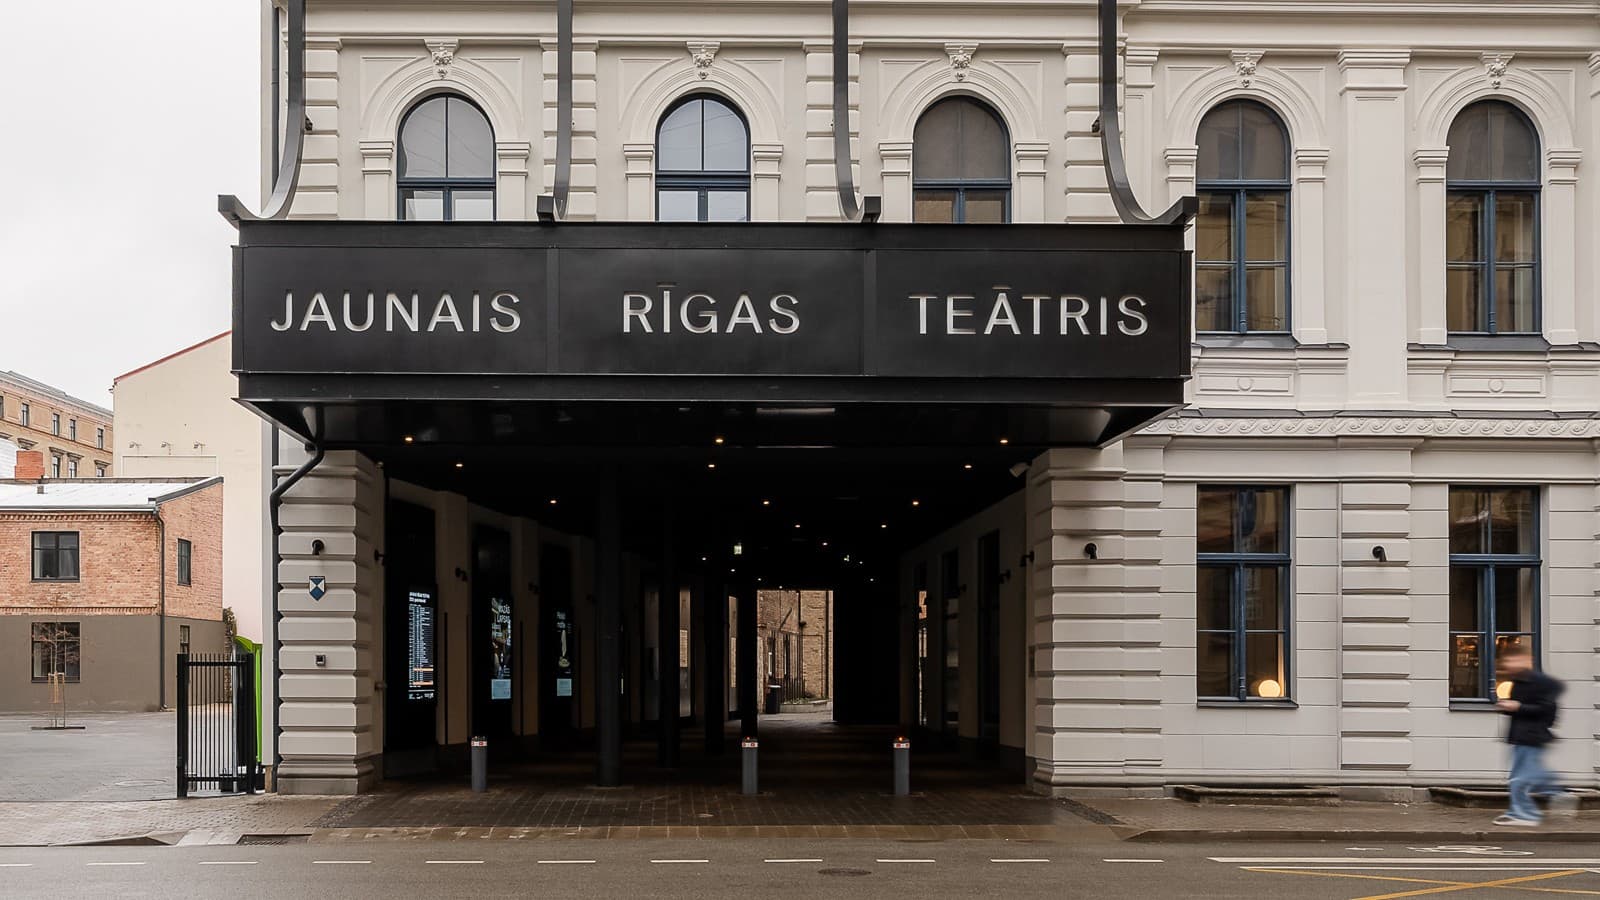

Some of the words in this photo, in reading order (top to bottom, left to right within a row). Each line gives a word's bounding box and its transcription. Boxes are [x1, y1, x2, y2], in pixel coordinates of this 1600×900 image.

[270, 291, 522, 334] JAUNAIS
[622, 282, 801, 335] RĪGAS
[908, 285, 1149, 336] TEĀTRIS
